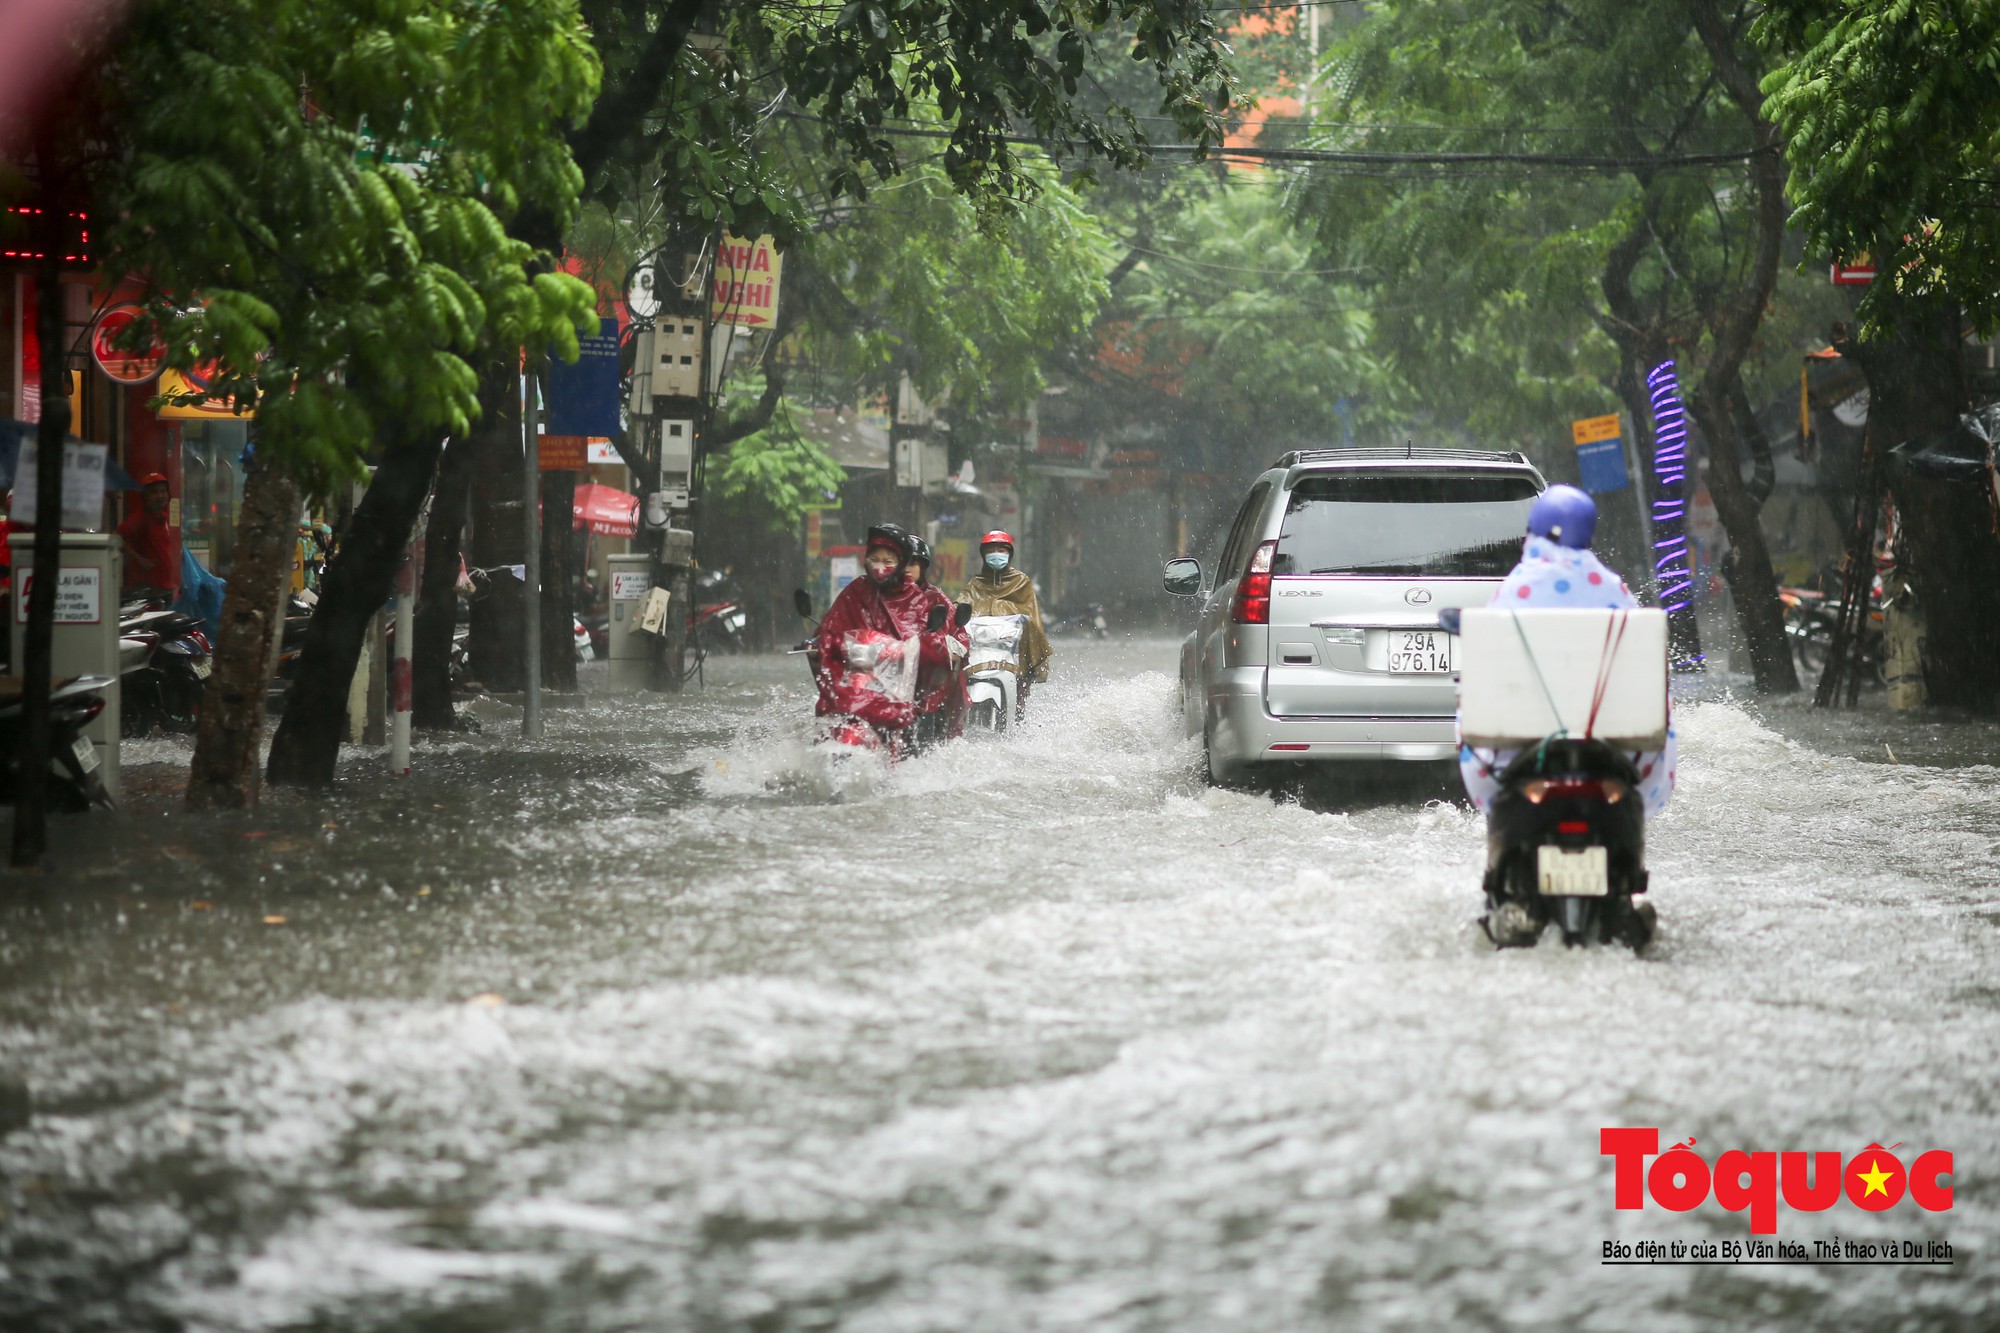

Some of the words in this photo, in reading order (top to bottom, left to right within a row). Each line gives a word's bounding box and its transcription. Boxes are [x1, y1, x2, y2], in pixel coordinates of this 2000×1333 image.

[717, 243, 770, 272] NHÀ
[713, 276, 774, 308] NGHỈ
[1404, 632, 1435, 651] 29A
[1391, 652, 1448, 671] 976.14
